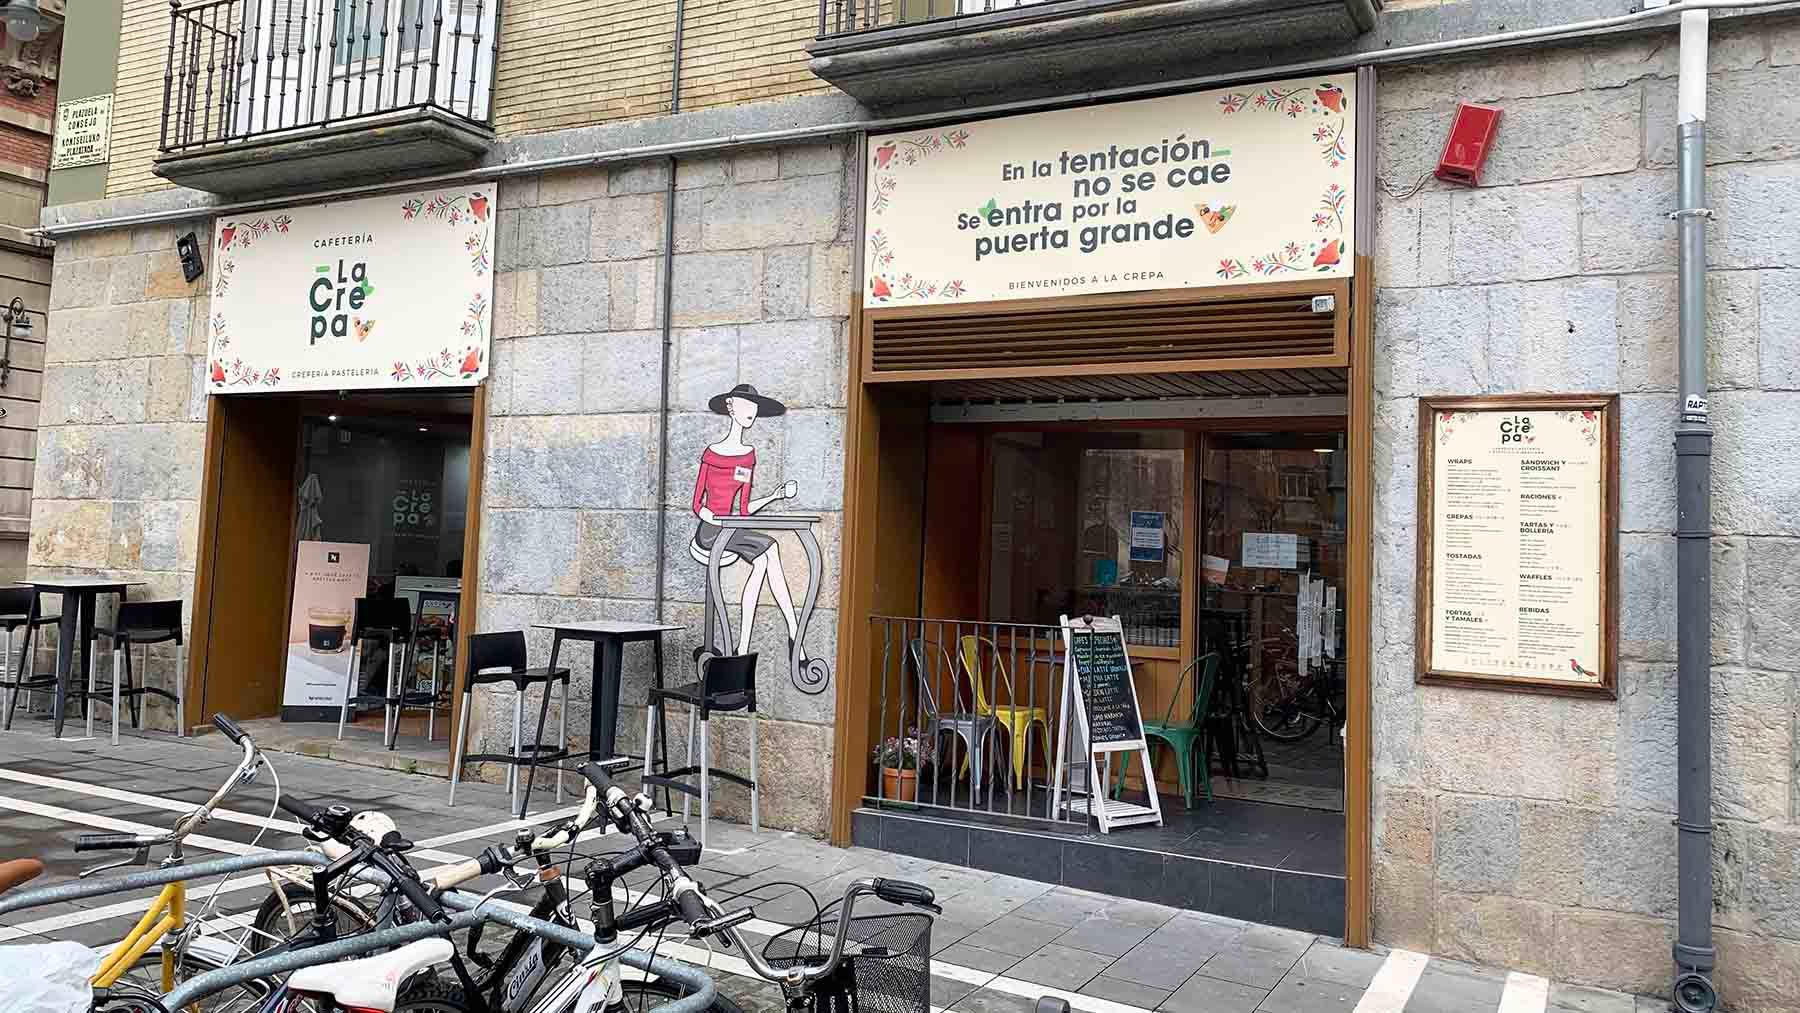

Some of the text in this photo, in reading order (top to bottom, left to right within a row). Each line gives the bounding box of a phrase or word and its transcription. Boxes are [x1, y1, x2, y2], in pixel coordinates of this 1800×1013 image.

[68, 117, 96, 130] CONSEJO
[72, 106, 97, 118] PLAZUELA
[1002, 134, 1210, 181] En la tentación
[1073, 162, 1230, 197] no se cae
[957, 197, 1137, 230] Se entra por la
[313, 232, 373, 248] CAFETERÍA
[975, 214, 1194, 261] puerta grande
[337, 259, 366, 283] La
[1008, 271, 1164, 290] BIENVENIDOS A LA CREPA
[309, 277, 366, 312] Cre
[310, 313, 348, 345] pa
[1514, 415, 1530, 424] La
[1502, 433, 1522, 444] pa
